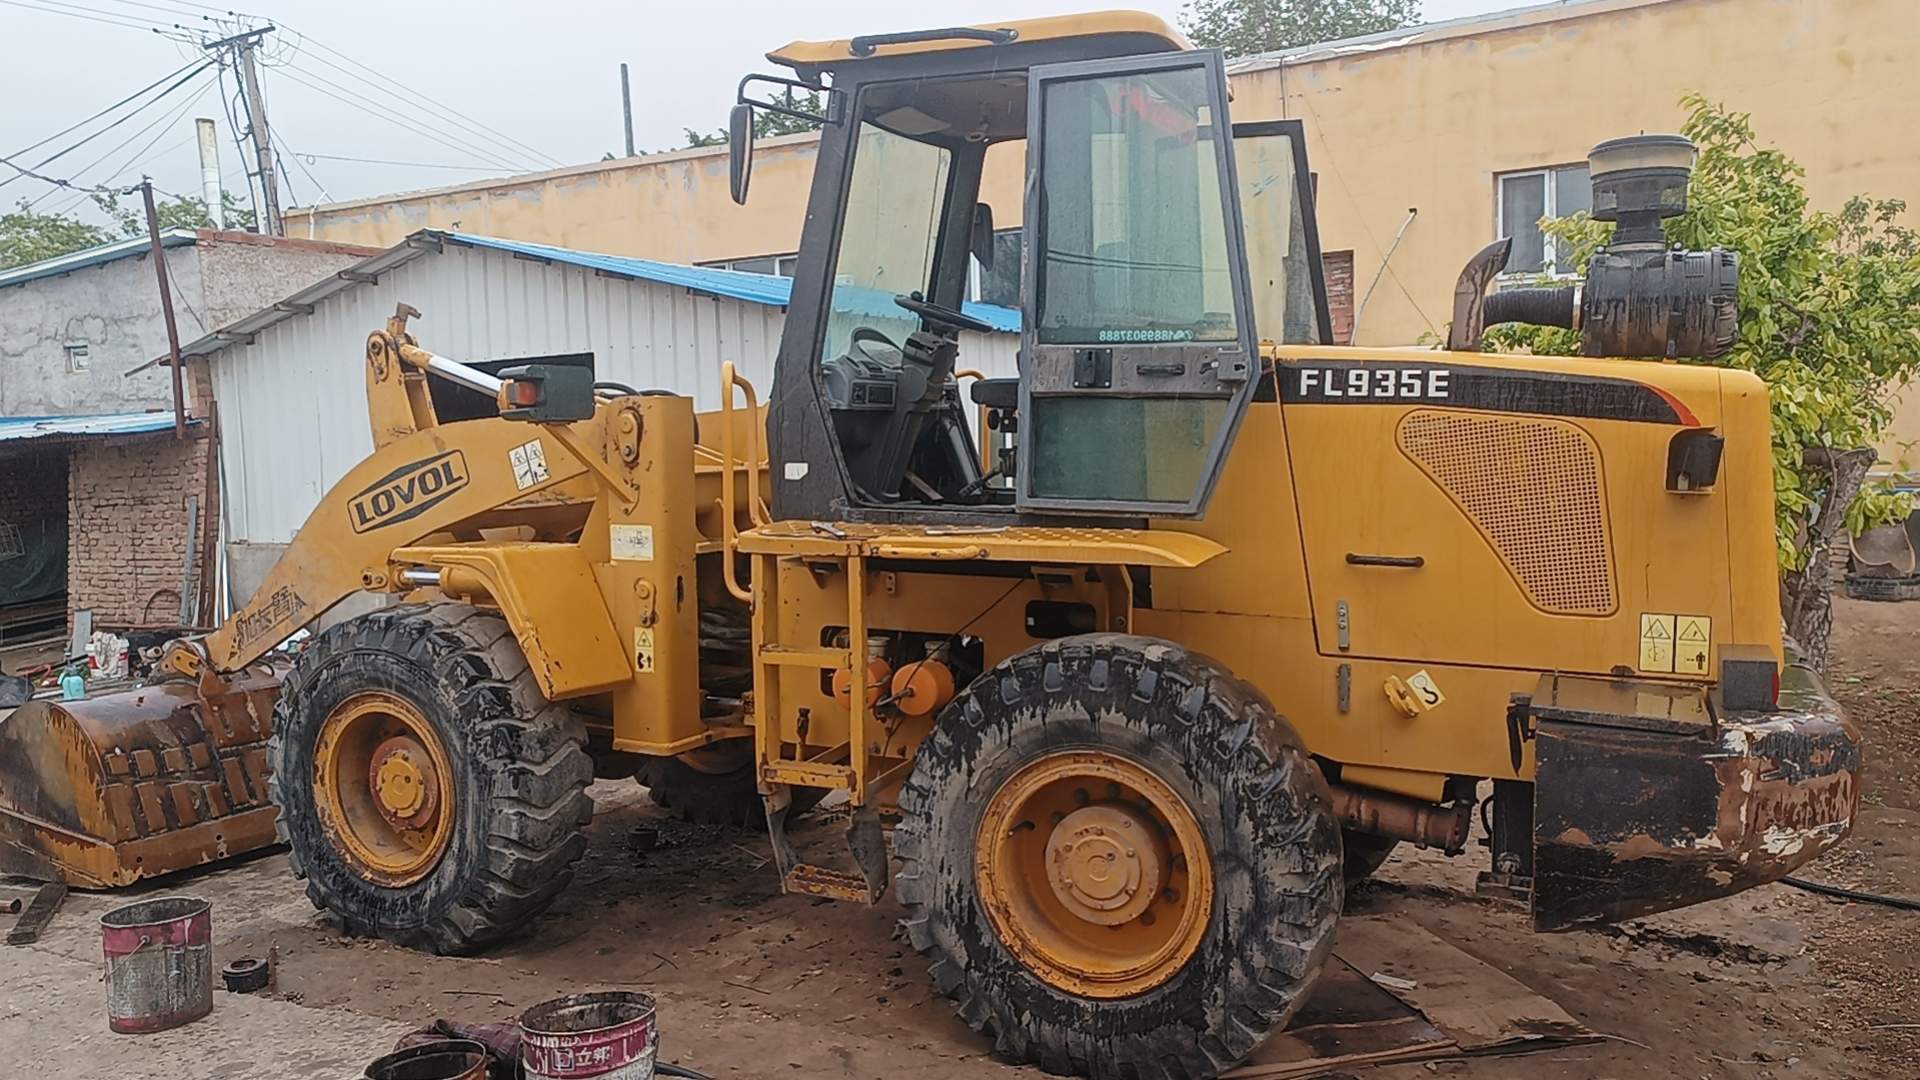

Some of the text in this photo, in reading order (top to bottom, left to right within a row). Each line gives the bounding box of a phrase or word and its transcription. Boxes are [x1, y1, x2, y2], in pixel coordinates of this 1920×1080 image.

[1300, 369, 1450, 397] FL935E
[354, 461, 464, 526] LOVOL
[575, 1046, 611, 1066] 立邦
